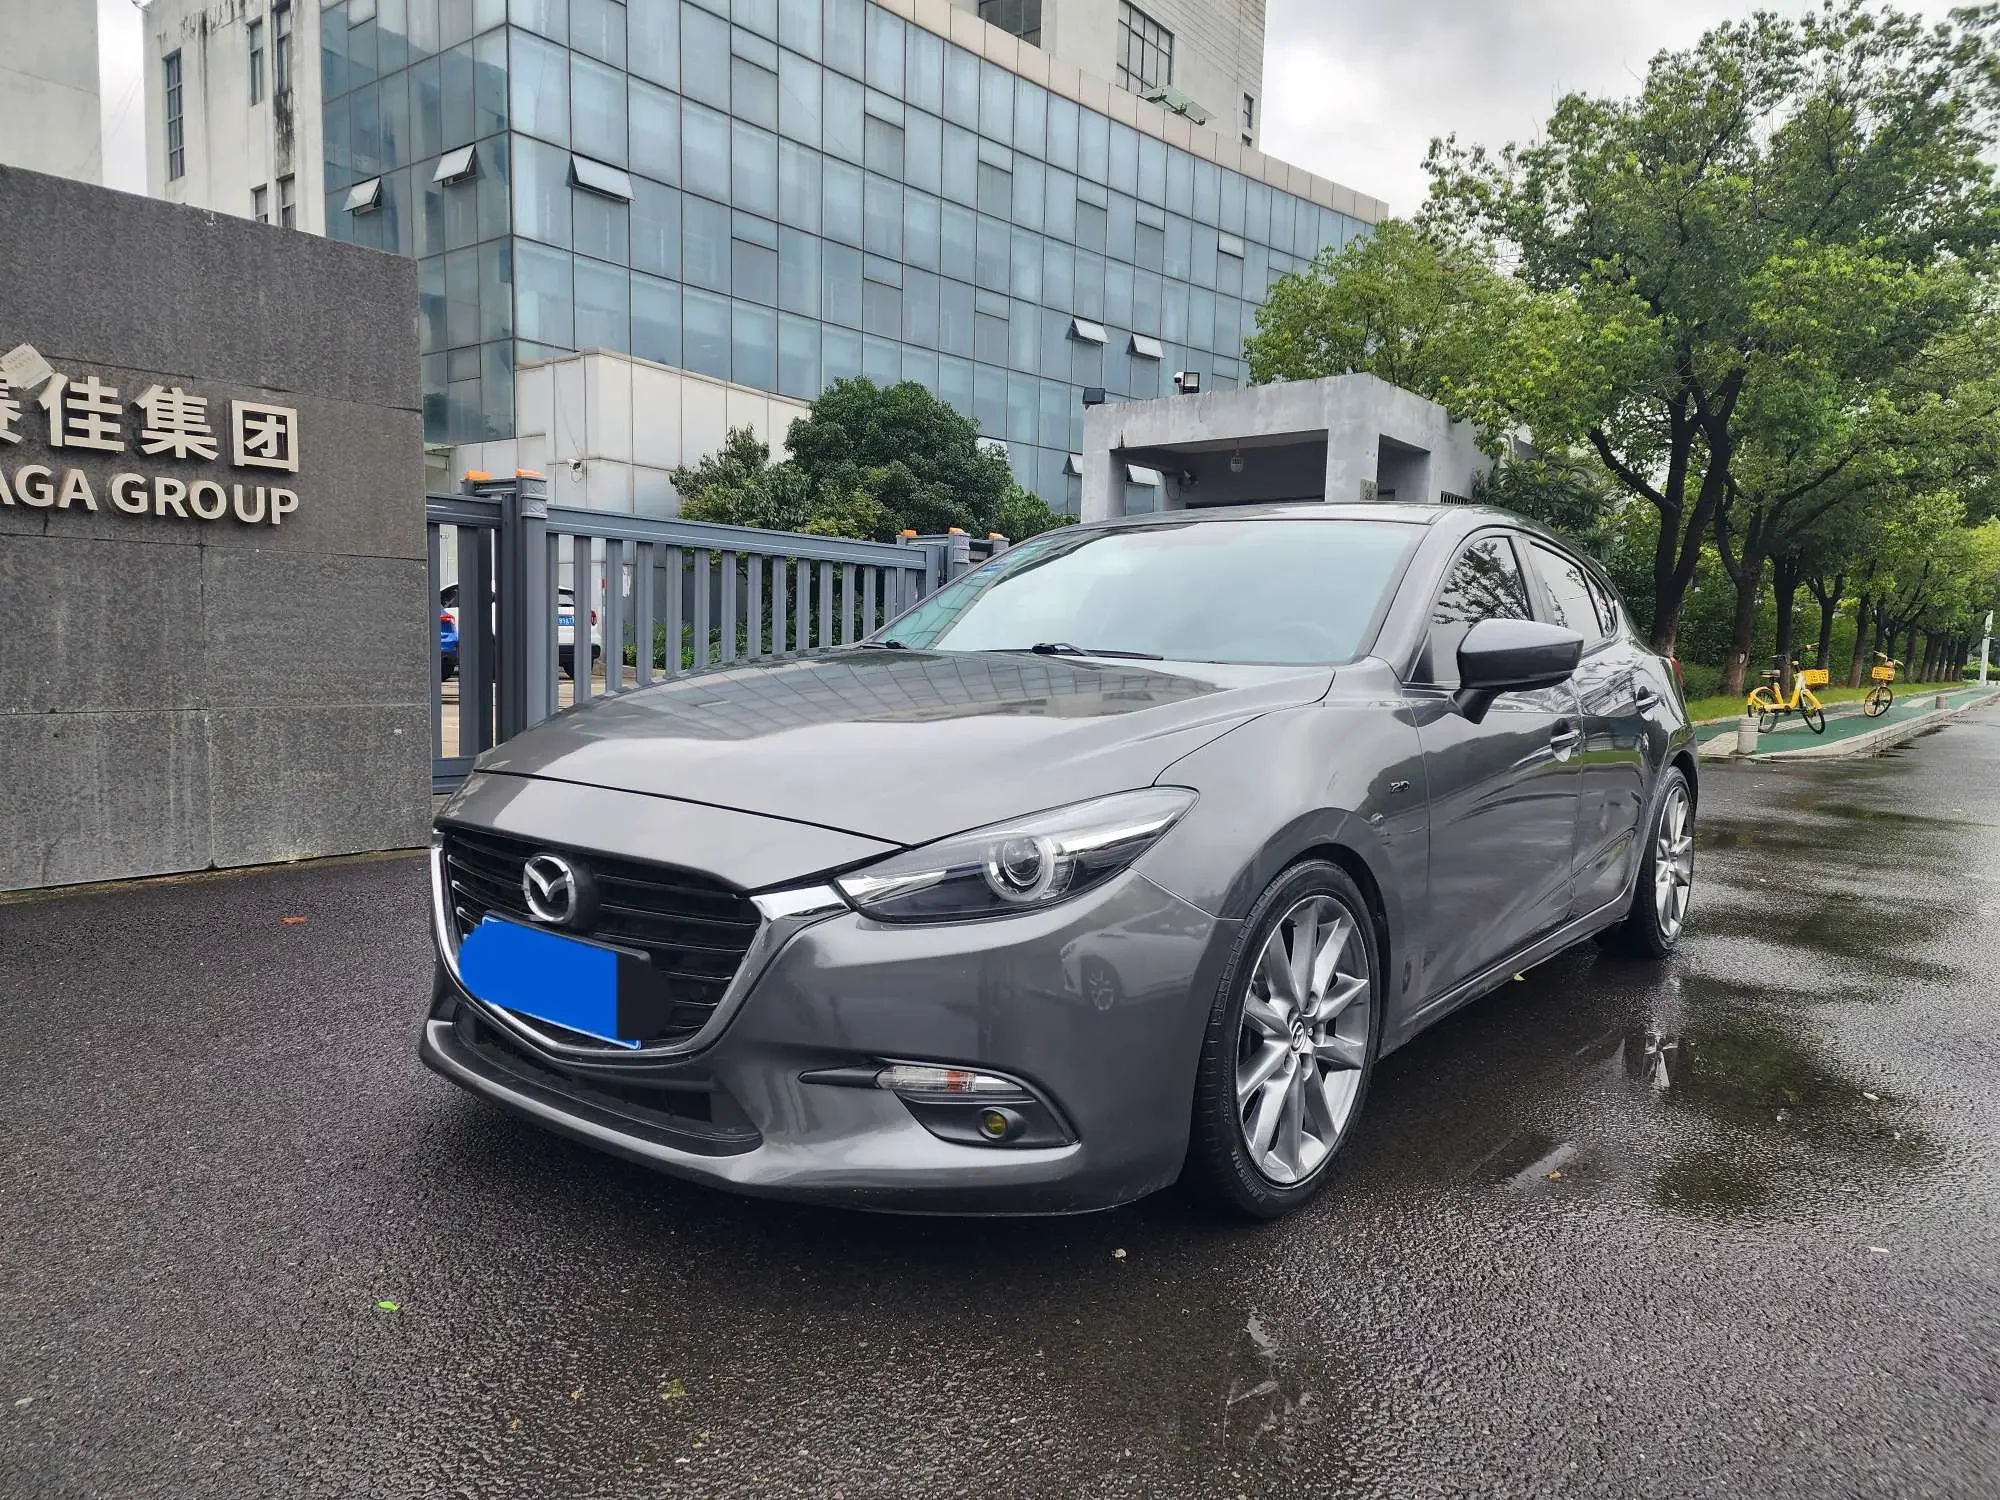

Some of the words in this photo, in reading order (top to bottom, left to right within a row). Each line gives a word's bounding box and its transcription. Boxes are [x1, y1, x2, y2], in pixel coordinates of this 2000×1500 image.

[0, 372, 299, 473] 佳集团
[110, 472, 299, 525] GROUP
